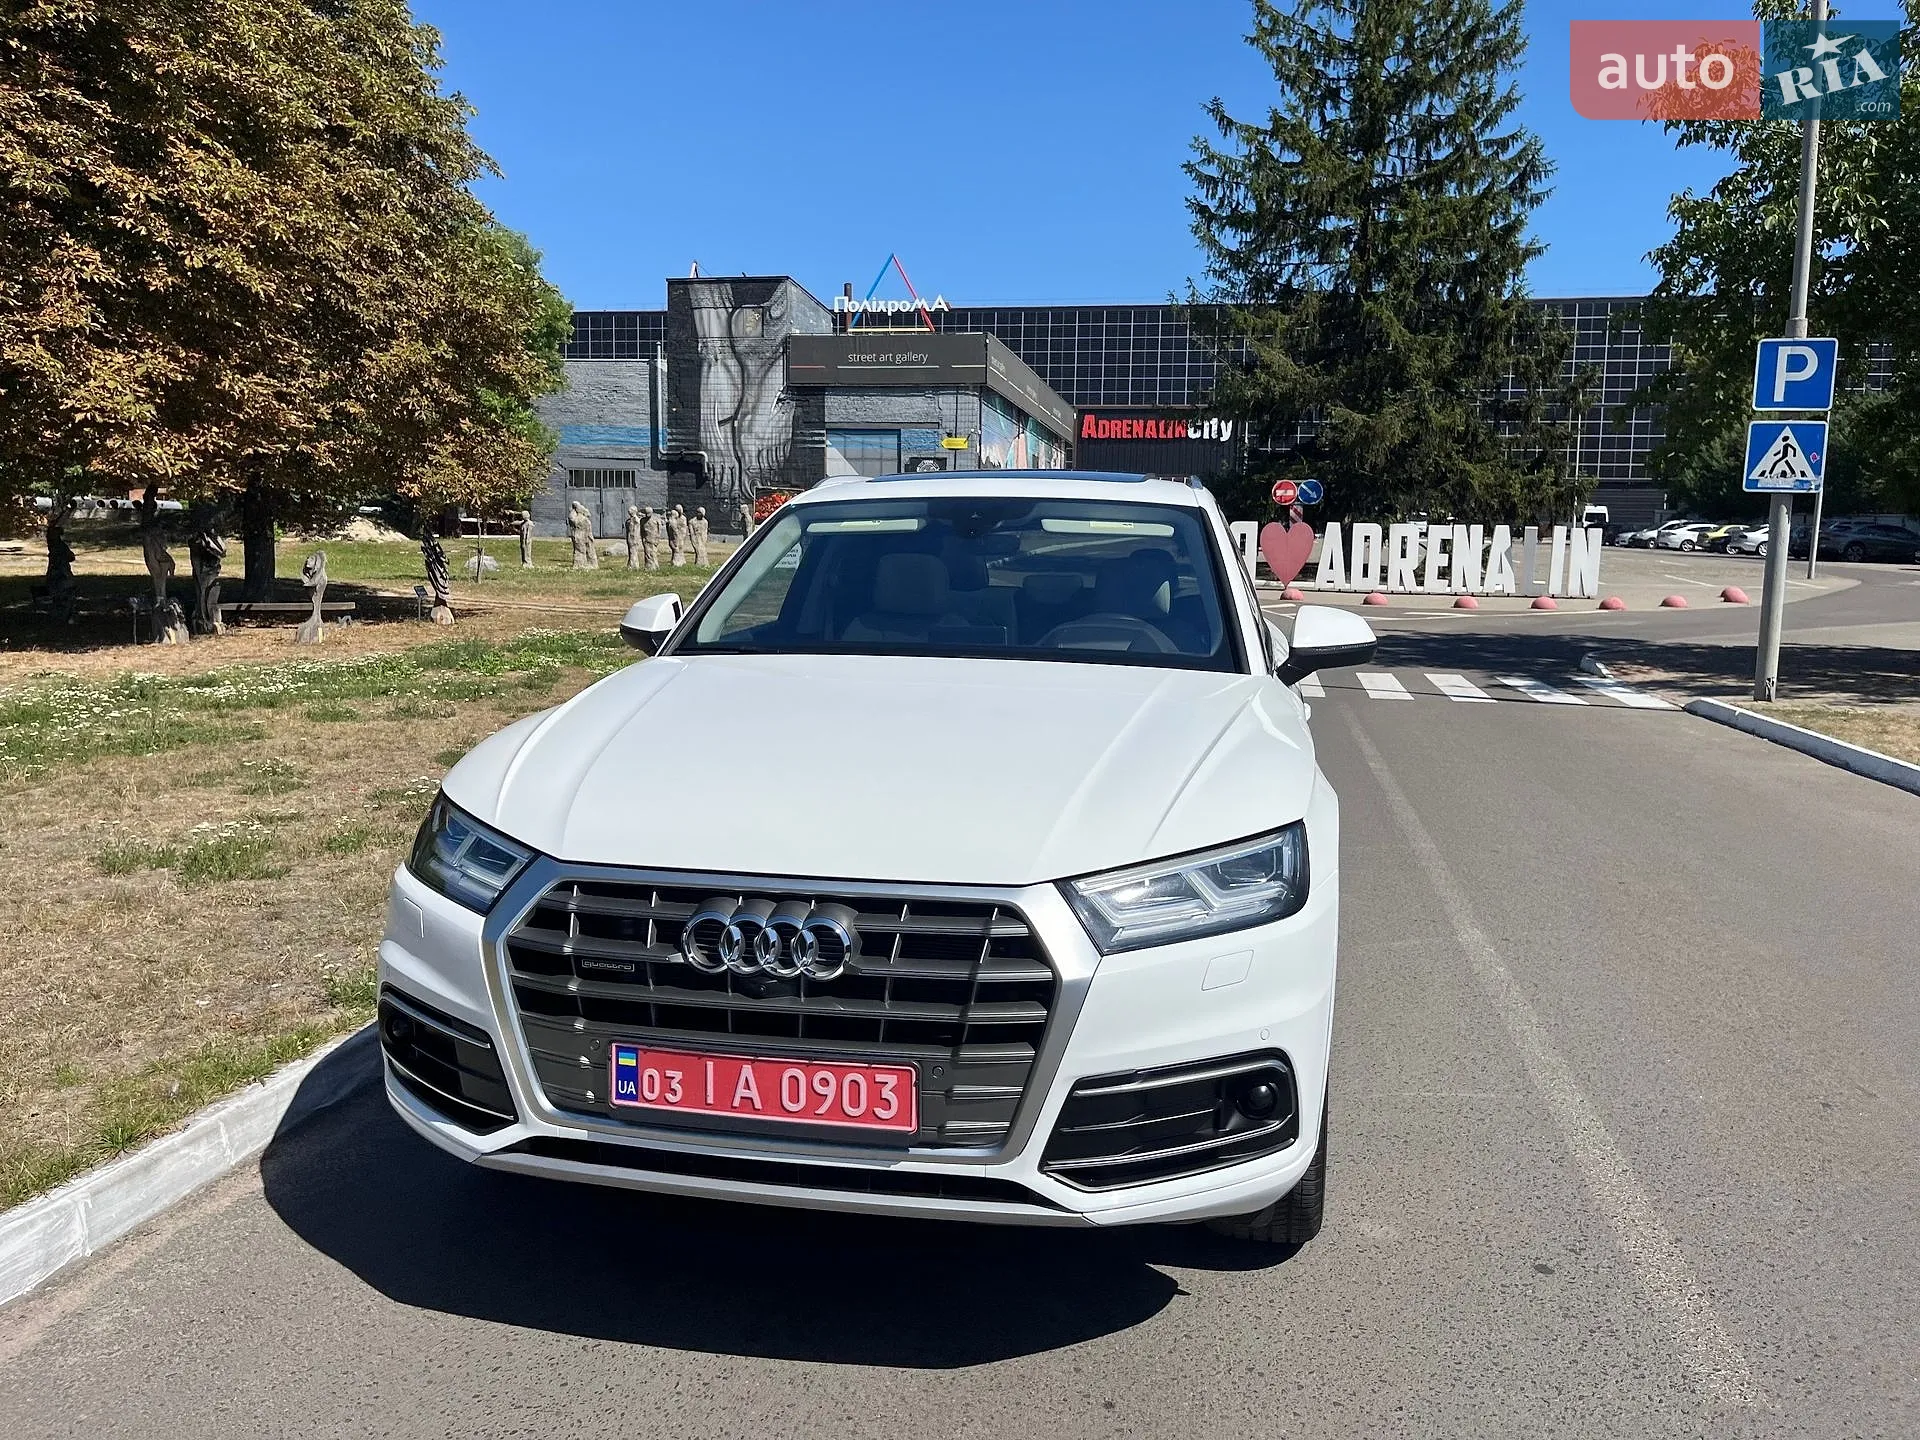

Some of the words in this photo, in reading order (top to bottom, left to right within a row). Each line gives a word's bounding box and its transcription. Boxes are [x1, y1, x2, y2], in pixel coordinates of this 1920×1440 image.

[847, 353, 877, 363] street
[879, 353, 893, 363] art
[895, 351, 929, 365] gallery
[1773, 345, 1819, 403] P
[1315, 521, 1603, 597] ADRENALIN
[584, 960, 632, 970] quattro
[618, 1079, 636, 1095] UA
[642, 1067, 684, 1104] 03
[780, 1067, 899, 1120] 0903
